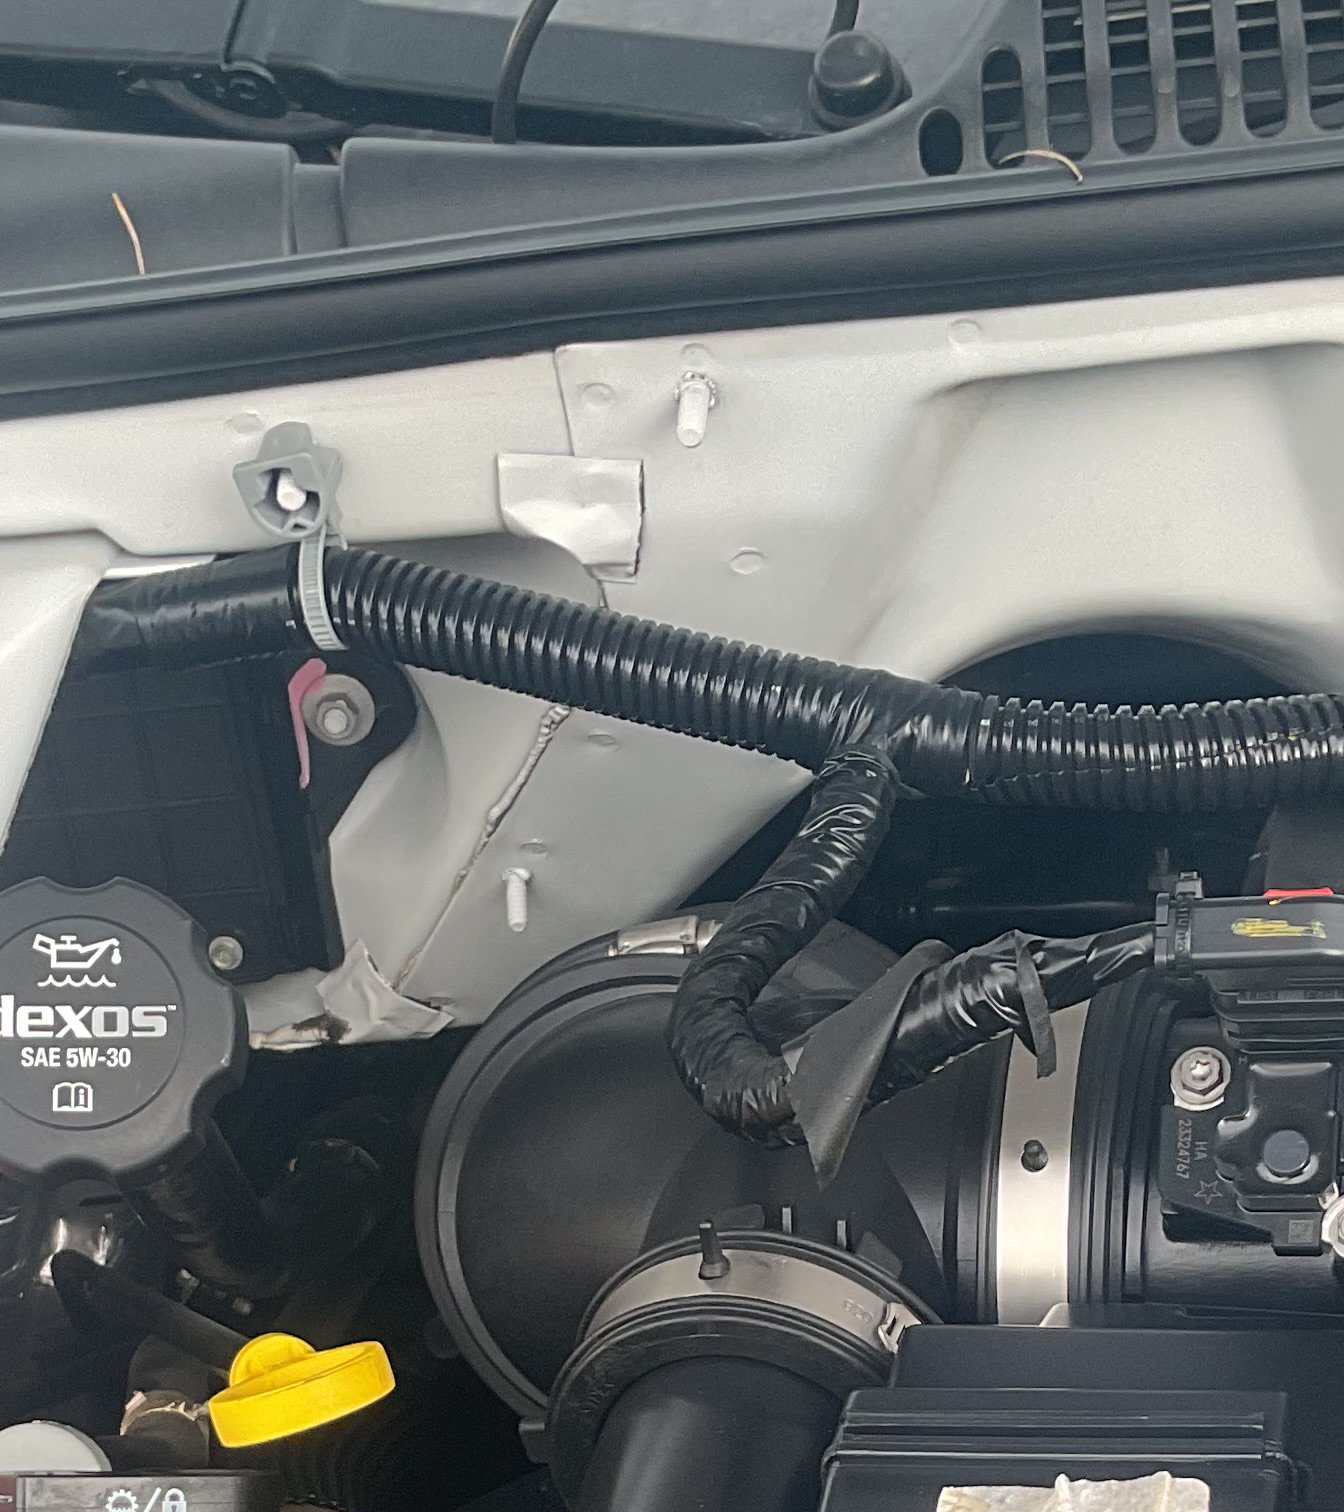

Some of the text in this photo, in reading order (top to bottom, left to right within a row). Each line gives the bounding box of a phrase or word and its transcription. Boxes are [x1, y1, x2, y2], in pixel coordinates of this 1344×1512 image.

[21, 1047, 132, 1067] SAE 5W-30
[1176, 1118, 1193, 1181] 23324767
[1194, 1140, 1209, 1161] HA
